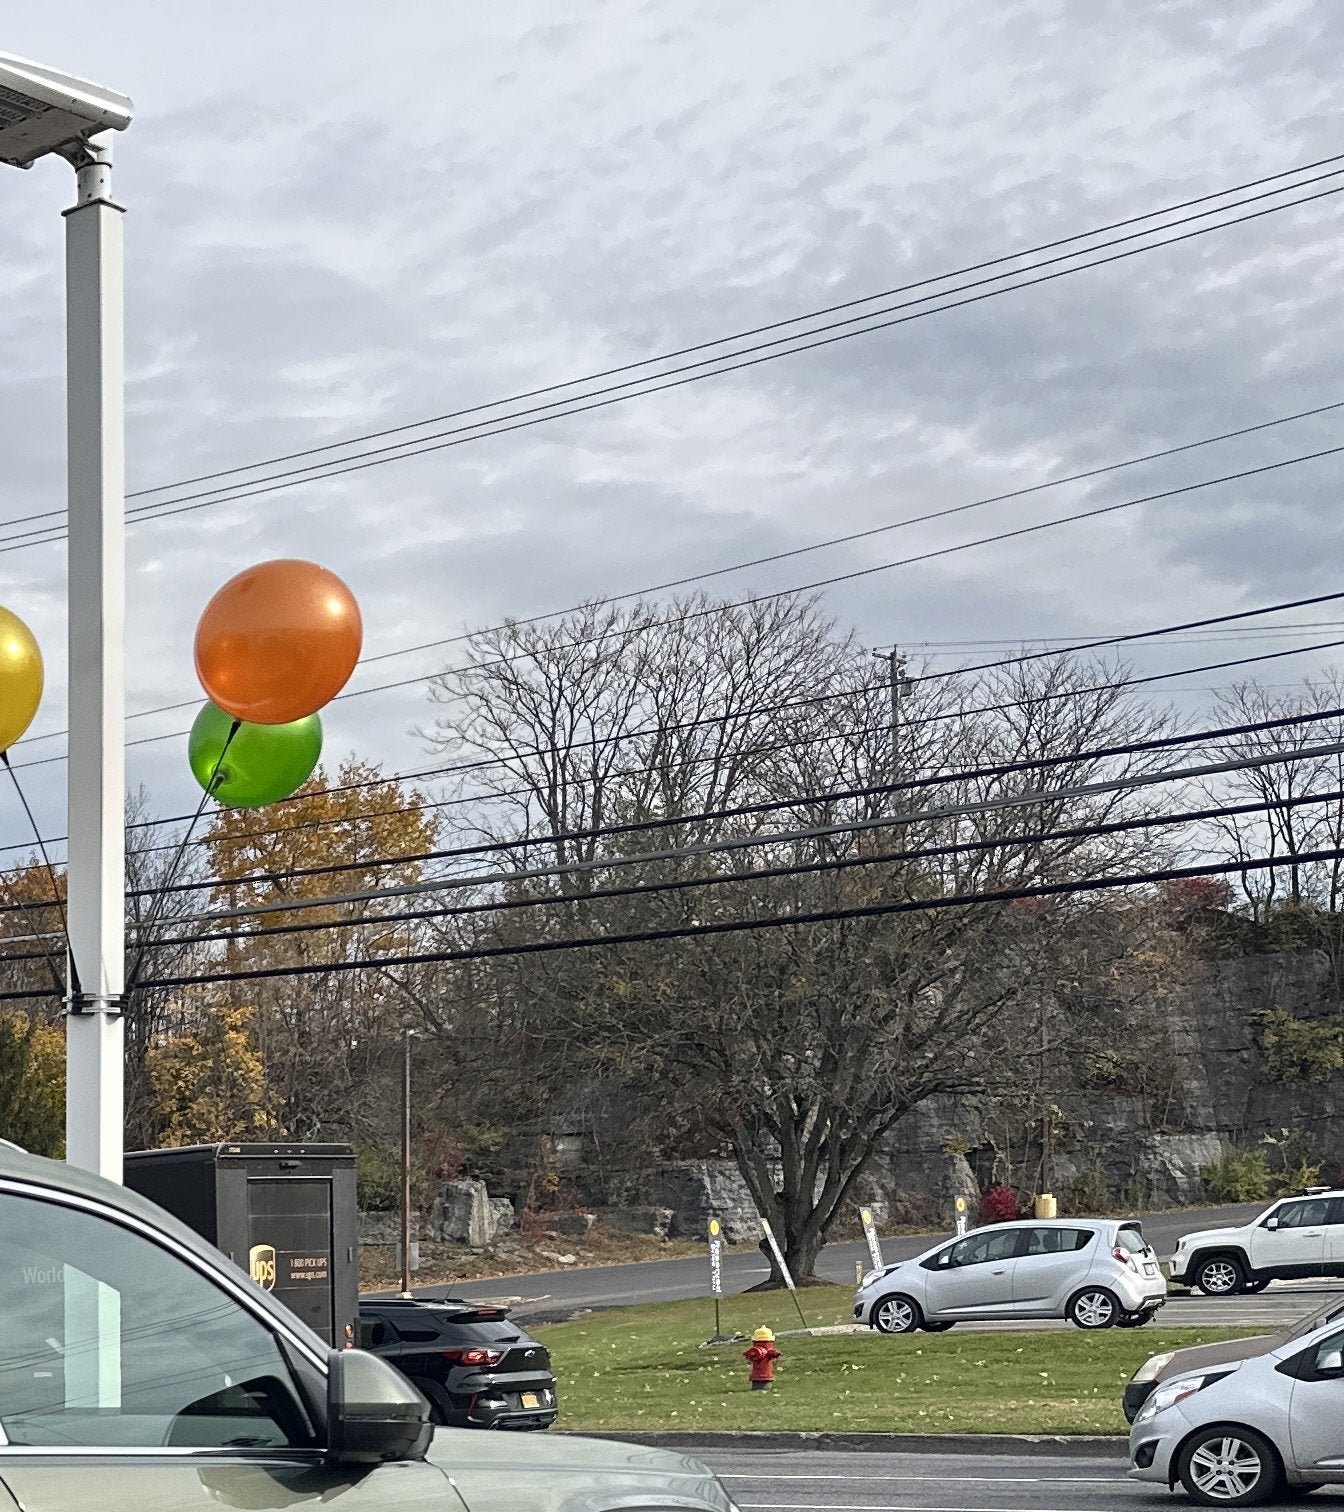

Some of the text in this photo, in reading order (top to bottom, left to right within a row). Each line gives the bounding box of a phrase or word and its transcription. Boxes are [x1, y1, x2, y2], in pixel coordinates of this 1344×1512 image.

[305, 1258, 316, 1267] PICK
[317, 1257, 327, 1267] UPS
[253, 1260, 275, 1288] ups
